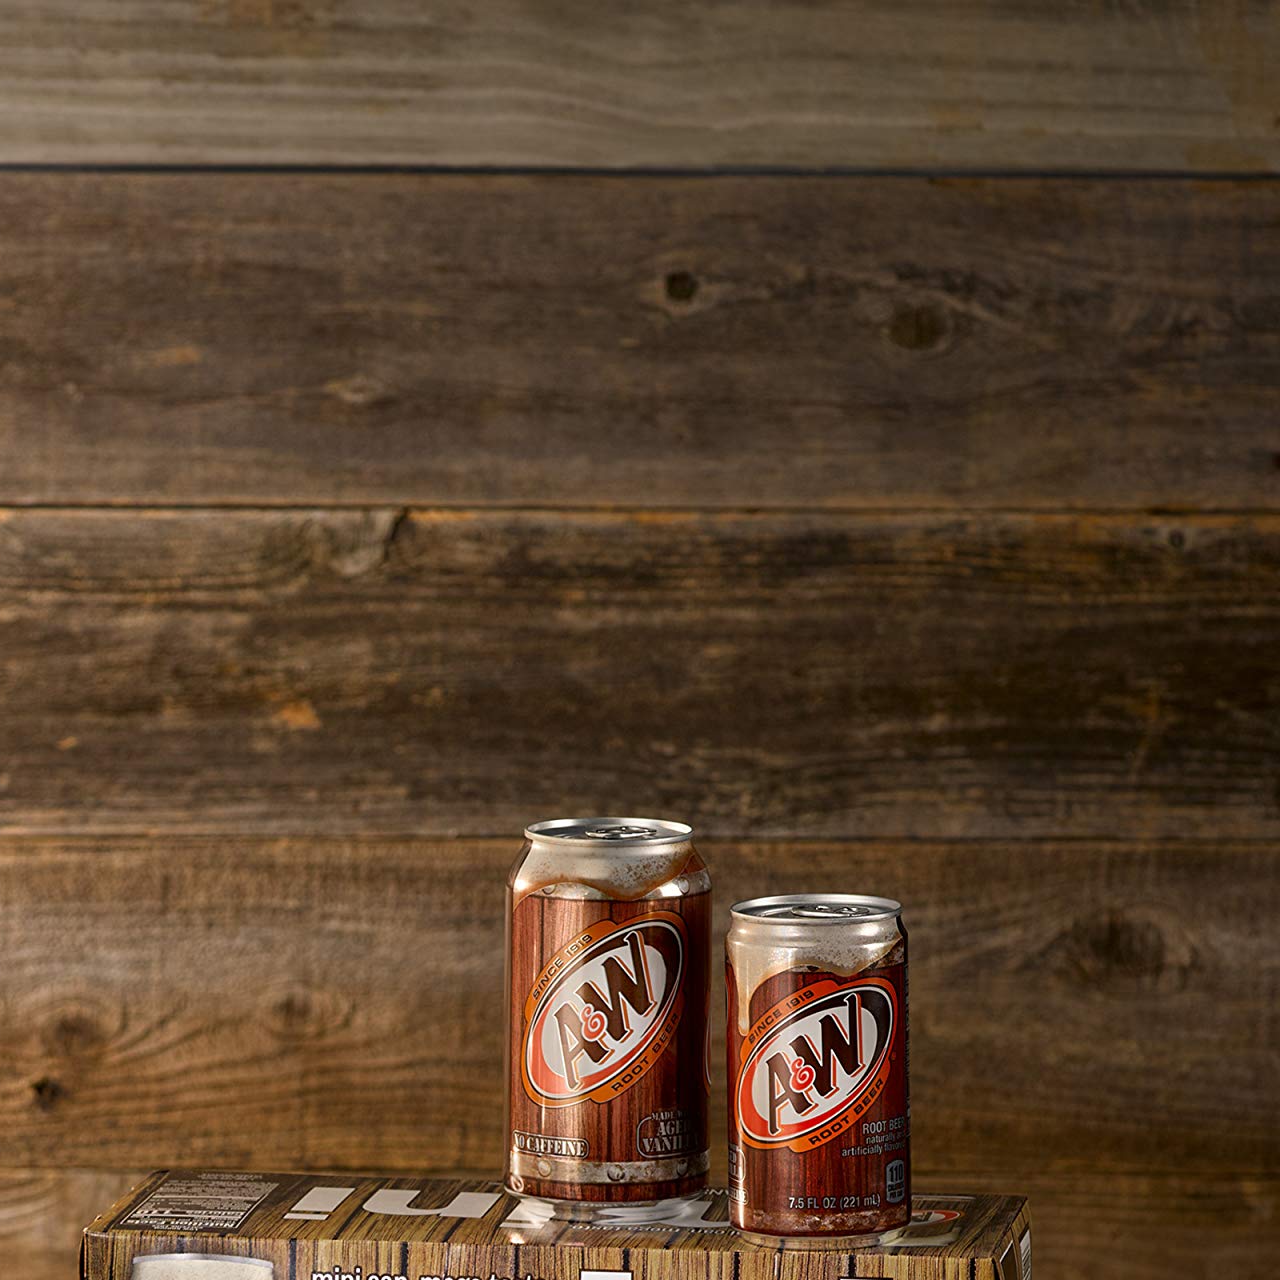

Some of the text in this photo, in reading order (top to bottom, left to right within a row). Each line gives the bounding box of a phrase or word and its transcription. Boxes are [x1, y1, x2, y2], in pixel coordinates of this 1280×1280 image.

[532, 933, 593, 1000] SINCE 1919
[554, 930, 658, 1092] A&W
[748, 989, 815, 1045] SINCE 1919
[611, 1012, 679, 1092] ROOT BEER
[766, 992, 867, 1136] A&W
[808, 1078, 884, 1146] ROOT BEER
[862, 1120, 887, 1135] ROOT
[526, 1136, 586, 1157] CAFFEINE
[841, 1144, 883, 1157] artificially
[788, 1196, 805, 1210] 7.5
[807, 1196, 820, 1210] FL
[823, 1196, 837, 1209] OZ
[839, 1195, 861, 1211] (221
[863, 1193, 882, 1209] mL)
